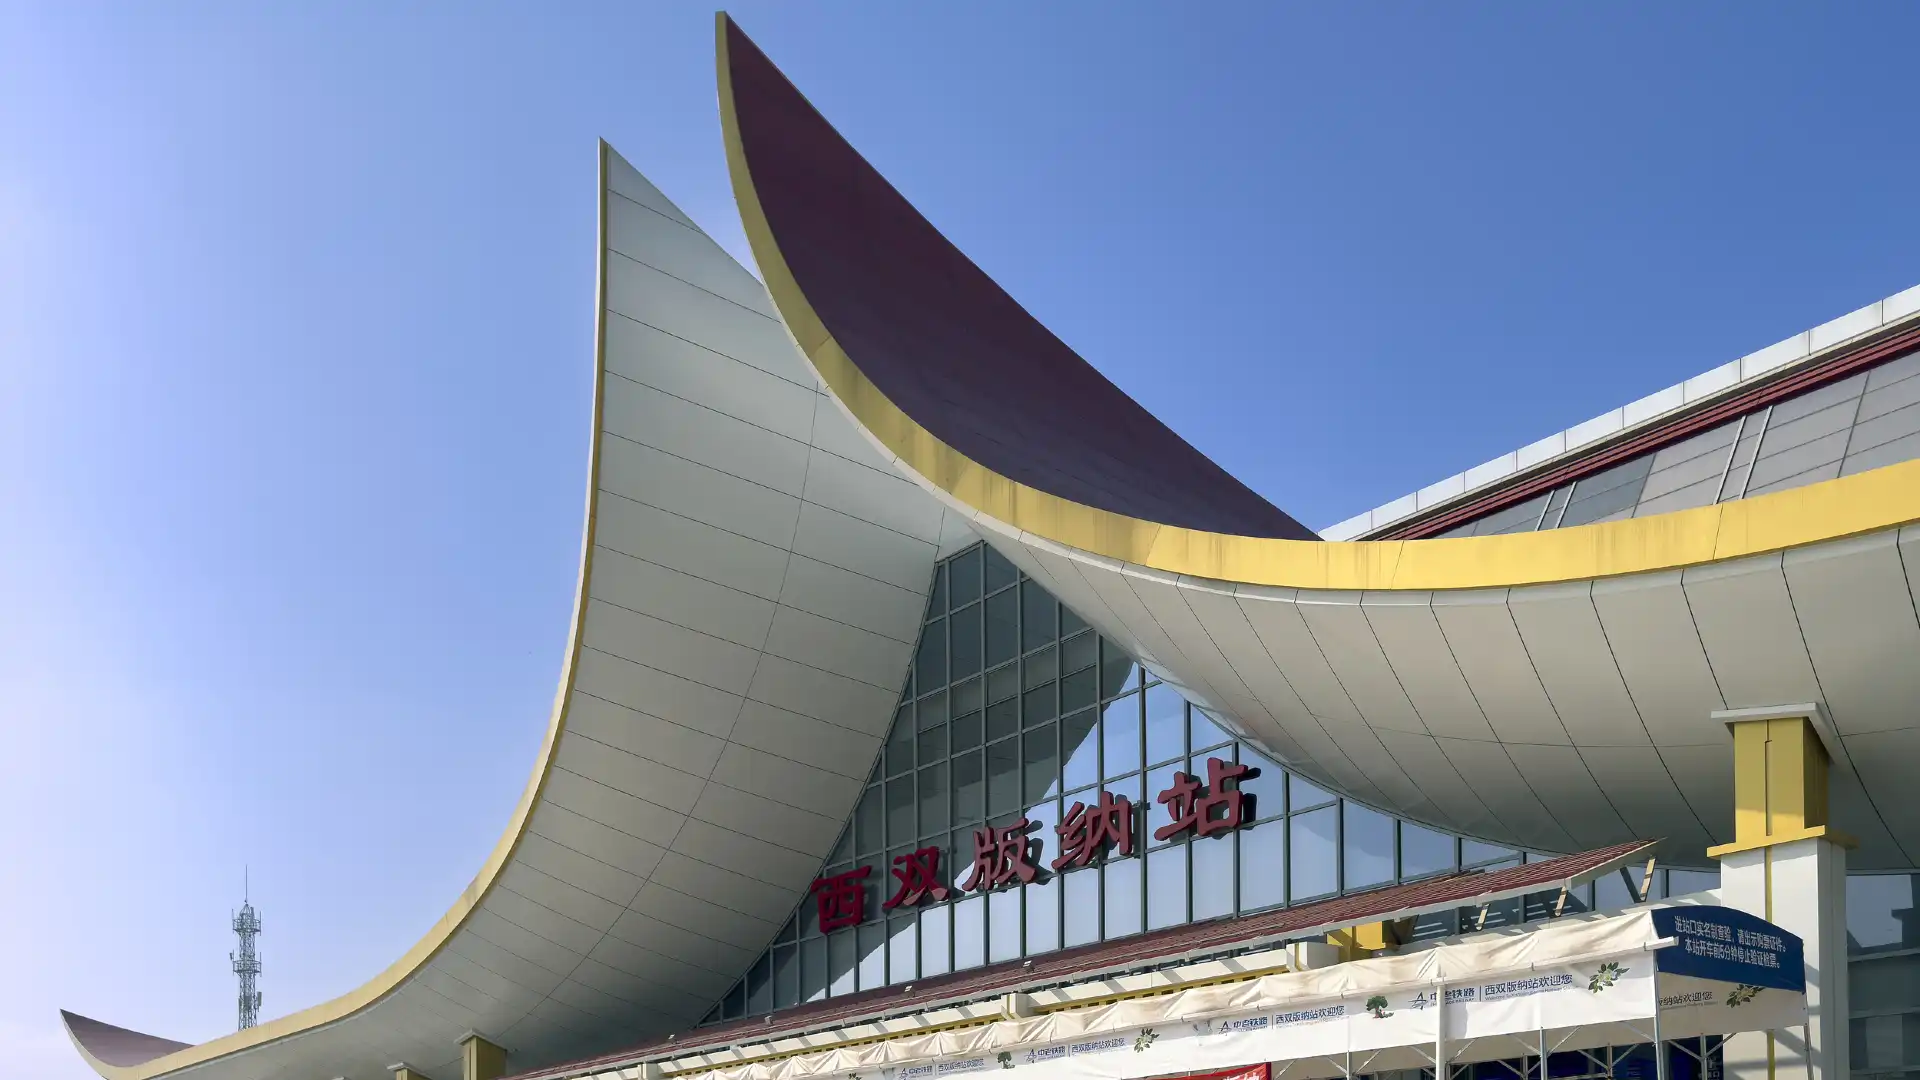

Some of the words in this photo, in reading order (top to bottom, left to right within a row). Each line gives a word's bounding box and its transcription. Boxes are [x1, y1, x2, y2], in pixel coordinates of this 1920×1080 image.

[811, 757, 1249, 934] 西双版纳站
[1485, 974, 1573, 996] 西双版纳站欢迎您
[1275, 1005, 1345, 1025] 西双版纳站欢迎您
[1071, 1037, 1125, 1053] 西双版纳站欢迎您
